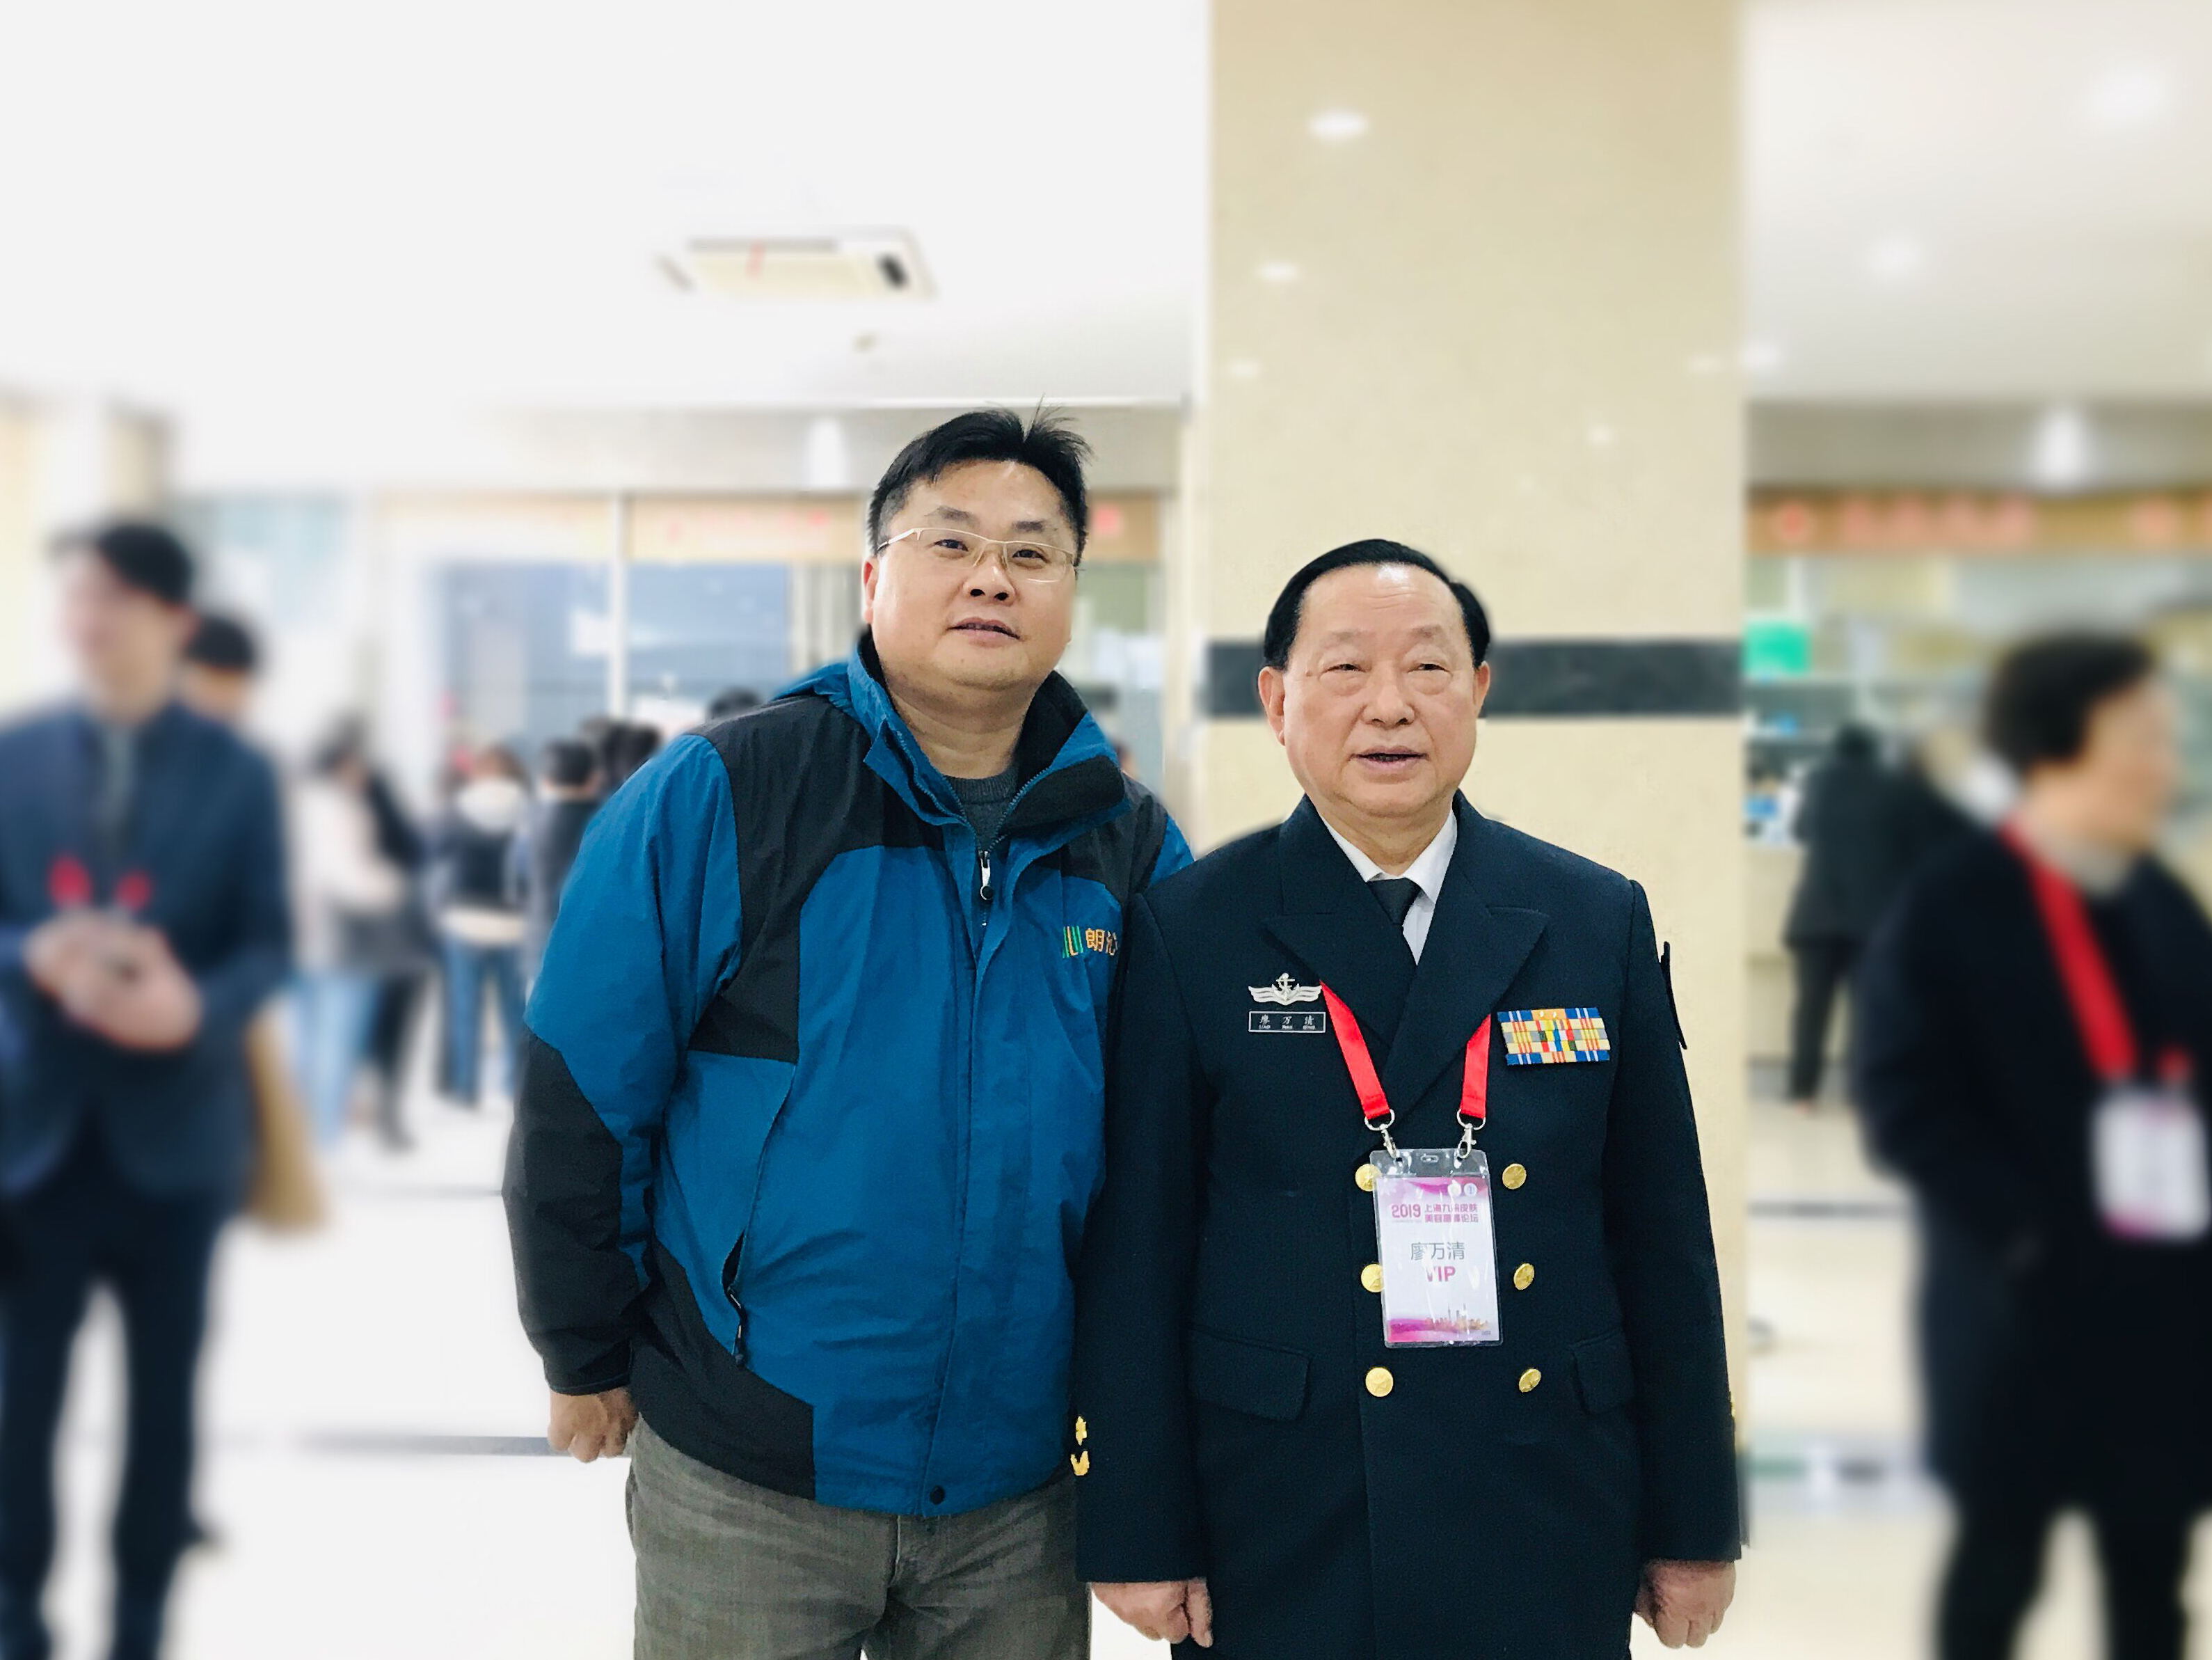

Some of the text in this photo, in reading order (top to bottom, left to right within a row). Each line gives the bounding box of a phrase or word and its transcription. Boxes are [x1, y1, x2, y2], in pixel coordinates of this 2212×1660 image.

[1391, 1203, 1422, 1218] 2019
[1410, 1242, 1466, 1260] 廖万清
[1426, 1265, 1456, 1282] VIP
